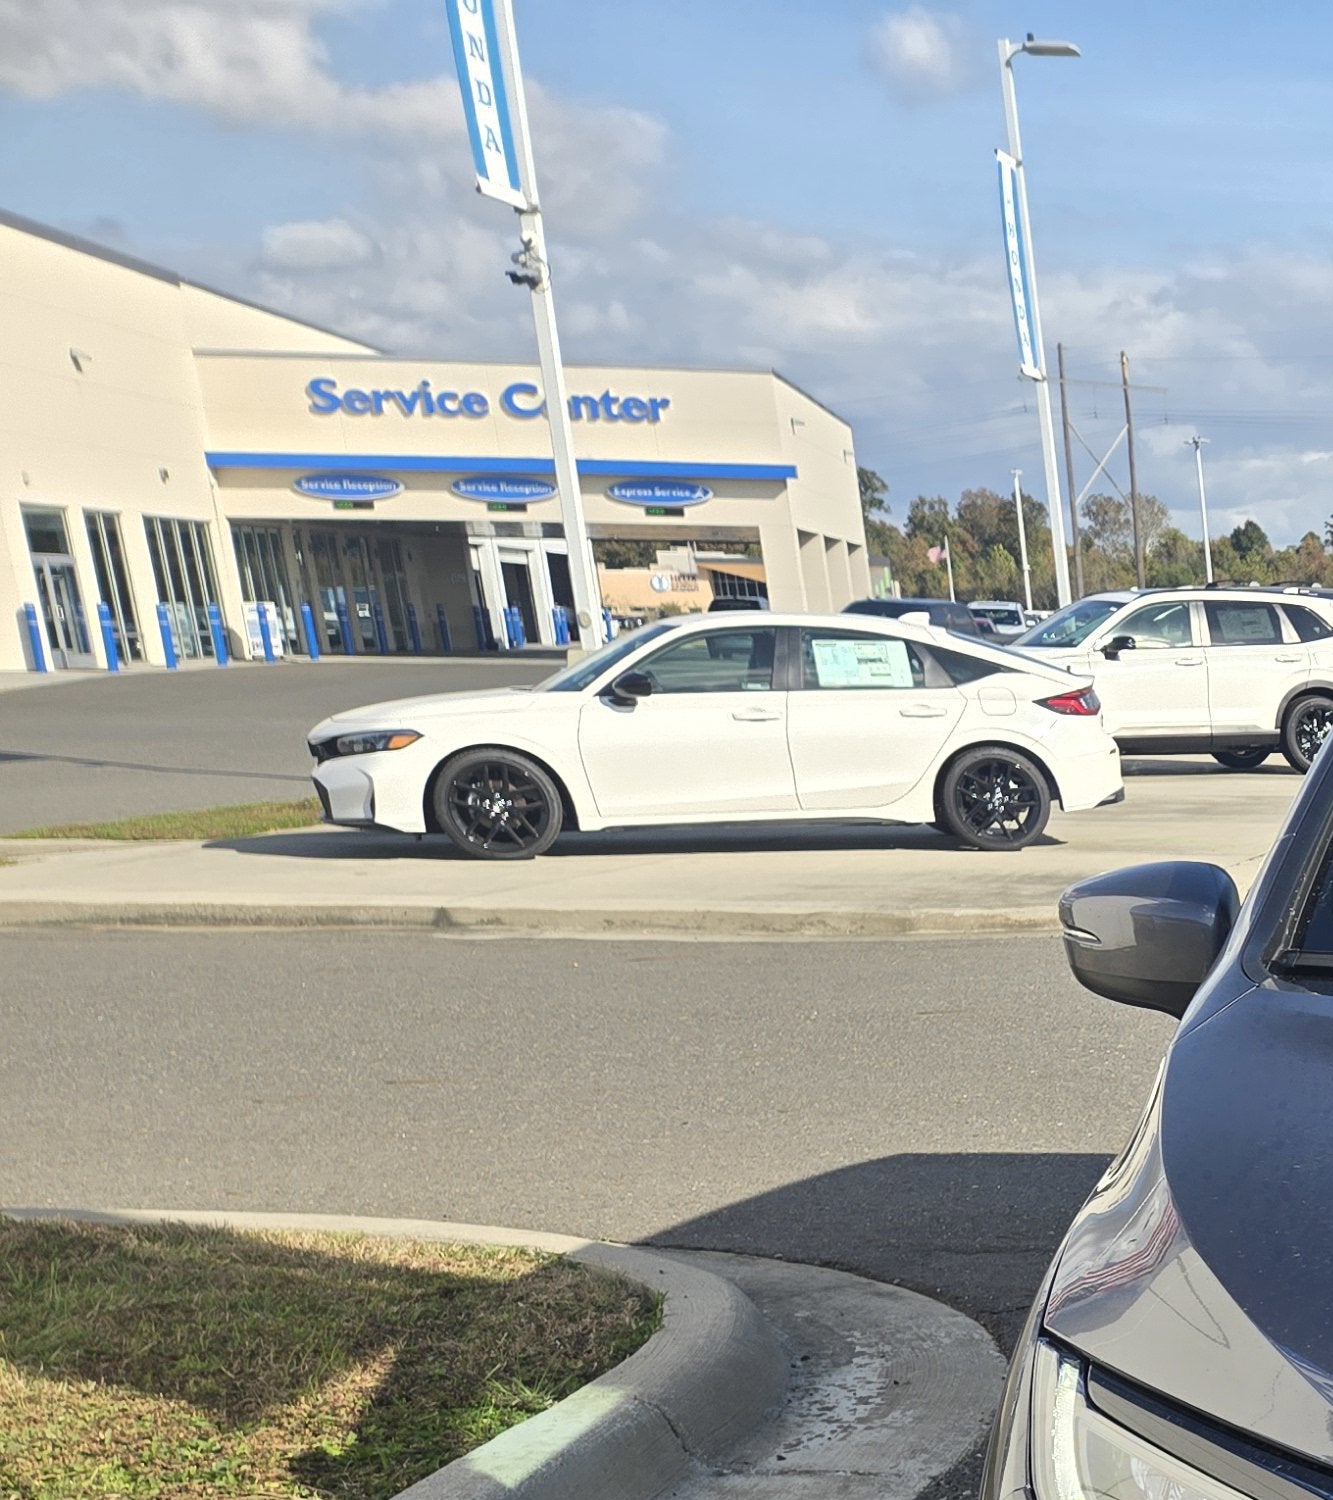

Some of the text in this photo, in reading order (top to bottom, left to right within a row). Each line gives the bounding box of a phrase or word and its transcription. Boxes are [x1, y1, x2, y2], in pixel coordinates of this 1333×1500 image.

[306, 377, 671, 423] Service Cnter
[301, 478, 397, 493] Service Reception
[459, 481, 552, 495] Service Reception
[613, 485, 690, 498] Express Service
